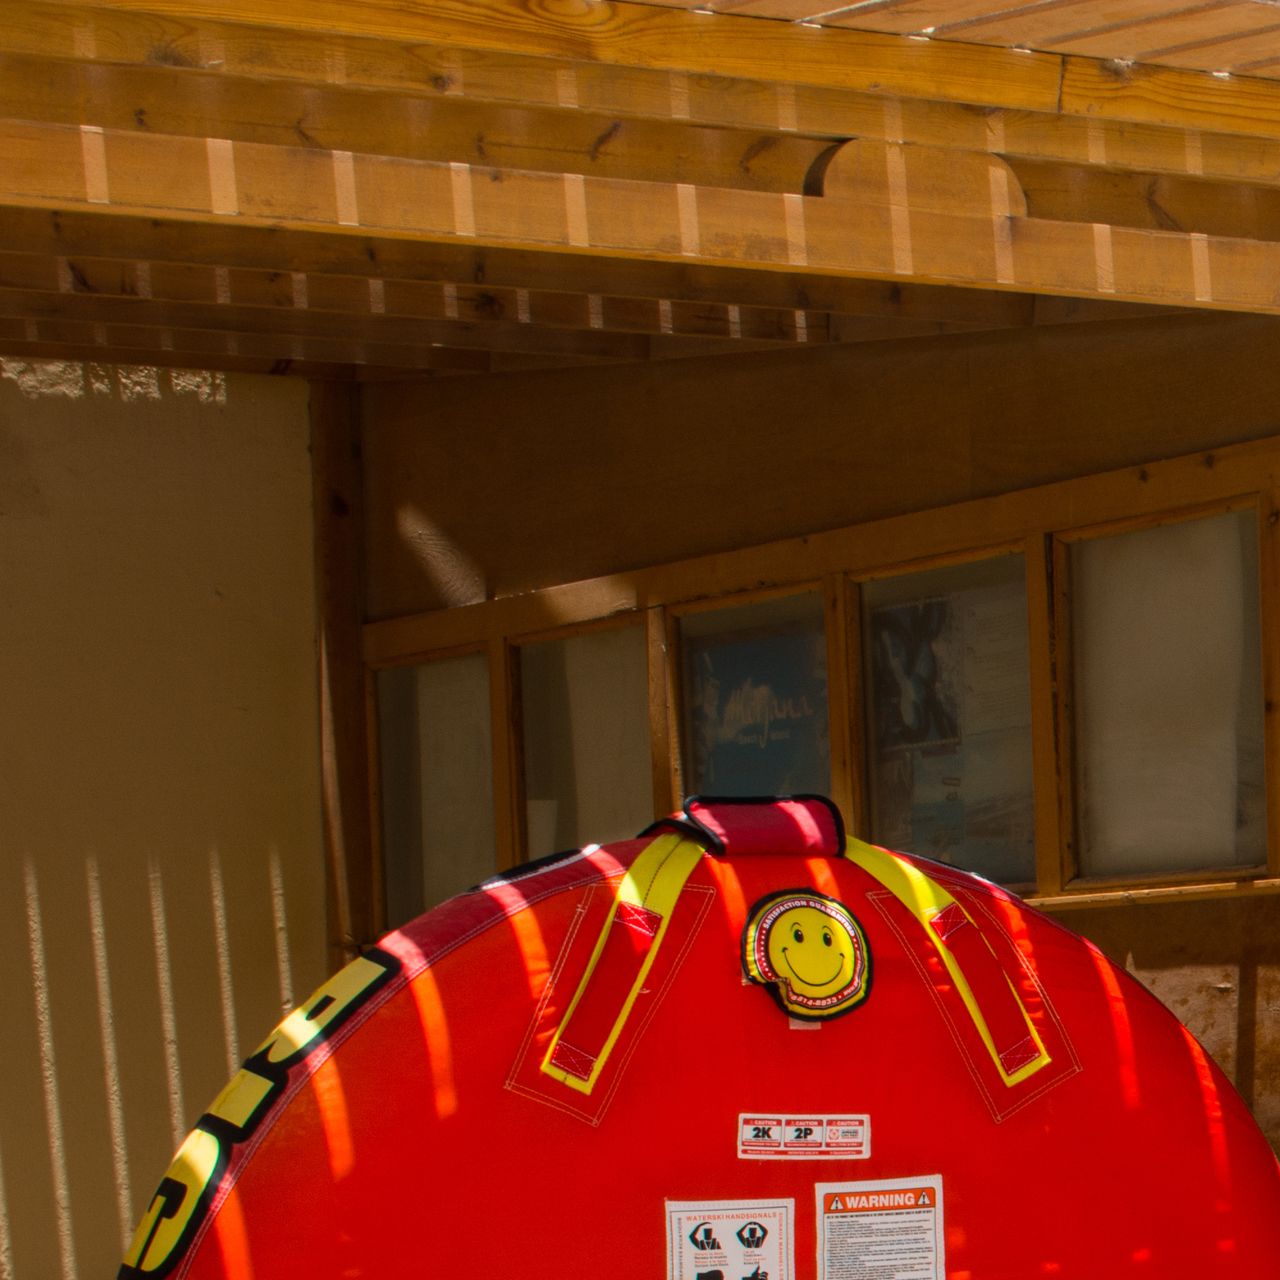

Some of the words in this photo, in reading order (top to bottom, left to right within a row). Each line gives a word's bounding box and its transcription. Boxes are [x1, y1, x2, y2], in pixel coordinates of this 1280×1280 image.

[763, 900, 807, 930] SATISFACTION
[752, 1126, 772, 1139] 2K
[794, 1127, 814, 1140] 2P
[845, 1192, 916, 1209] WARNING
[686, 1213, 725, 1222] WATERSKI
[726, 1211, 778, 1220] HANDSIGNALS
